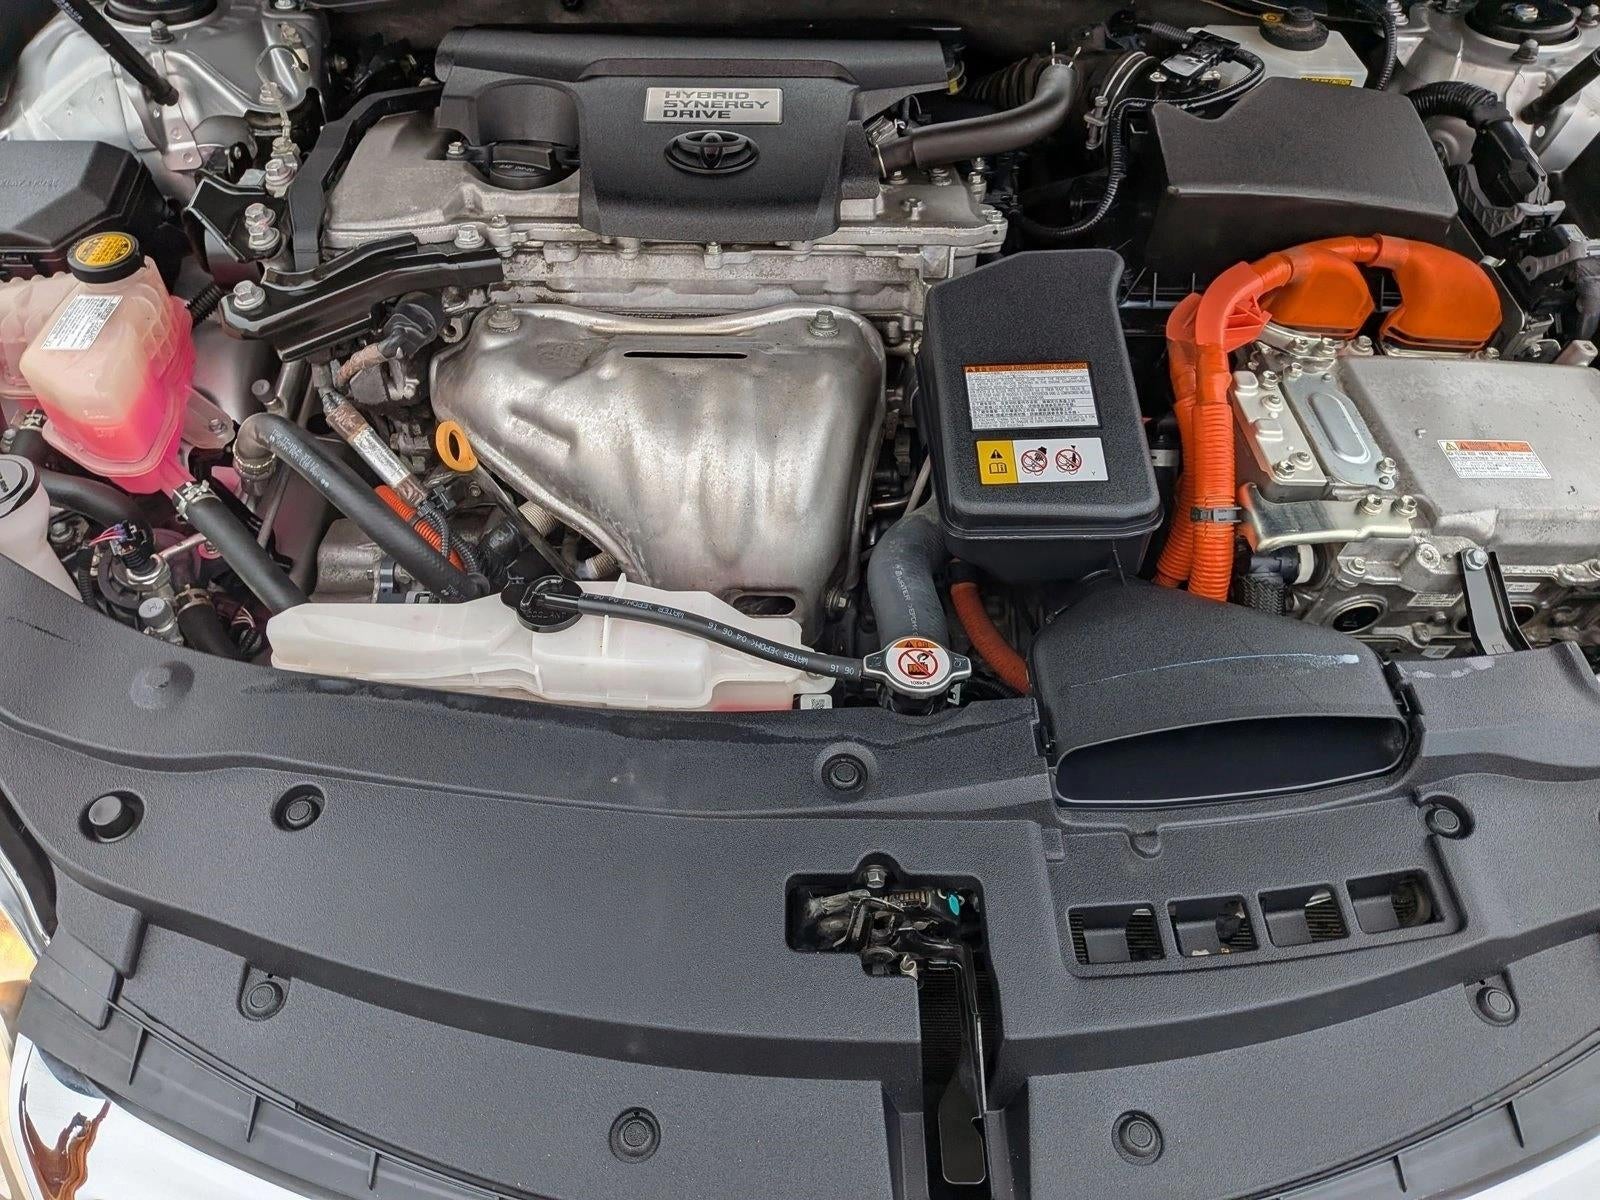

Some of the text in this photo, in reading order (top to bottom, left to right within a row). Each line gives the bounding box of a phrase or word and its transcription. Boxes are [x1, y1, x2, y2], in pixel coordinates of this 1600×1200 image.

[665, 91, 750, 100] HYBRID
[664, 100, 770, 109] SYNERGY
[663, 109, 732, 119] DRIVE
[707, 622, 718, 631] 16
[722, 627, 733, 637] 06
[736, 633, 748, 643] 04
[784, 651, 809, 665] WATER
[830, 664, 855, 675] 06 16
